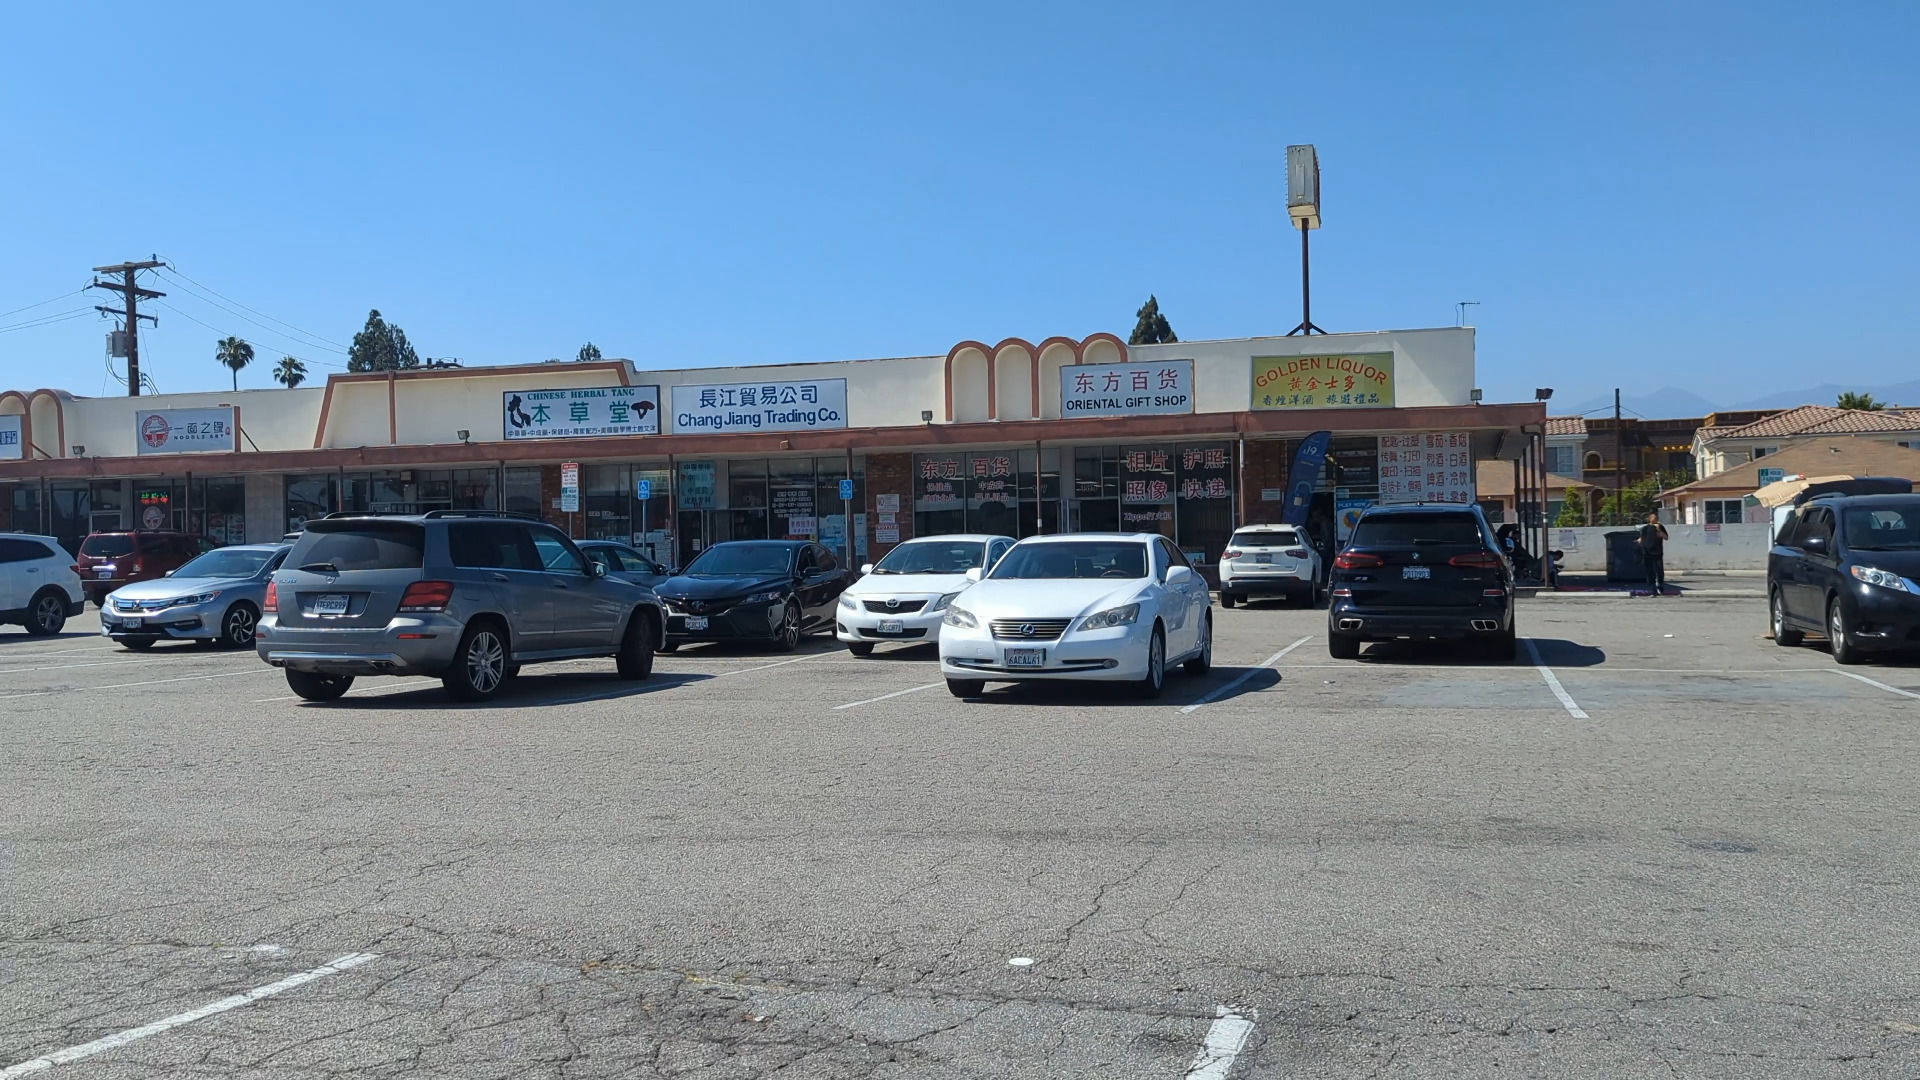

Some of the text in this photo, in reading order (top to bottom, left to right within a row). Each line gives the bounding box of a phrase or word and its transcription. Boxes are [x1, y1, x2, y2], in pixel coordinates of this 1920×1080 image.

[1075, 368, 1178, 394] 东方百货
[1256, 357, 1387, 388] GOLDEN LIQUOR
[527, 388, 635, 401] CHINESE HERBAL TANG
[699, 385, 818, 408] 長江貿易公司
[1066, 395, 1187, 410] ORIENTAL GIFT SHOP
[530, 400, 631, 426] 本草堂
[678, 407, 841, 430] Chang Jiang Trading Co.
[920, 456, 1011, 480] 东方 百货
[1126, 448, 1225, 472] 相片 护照
[1182, 477, 1226, 500] 快递
